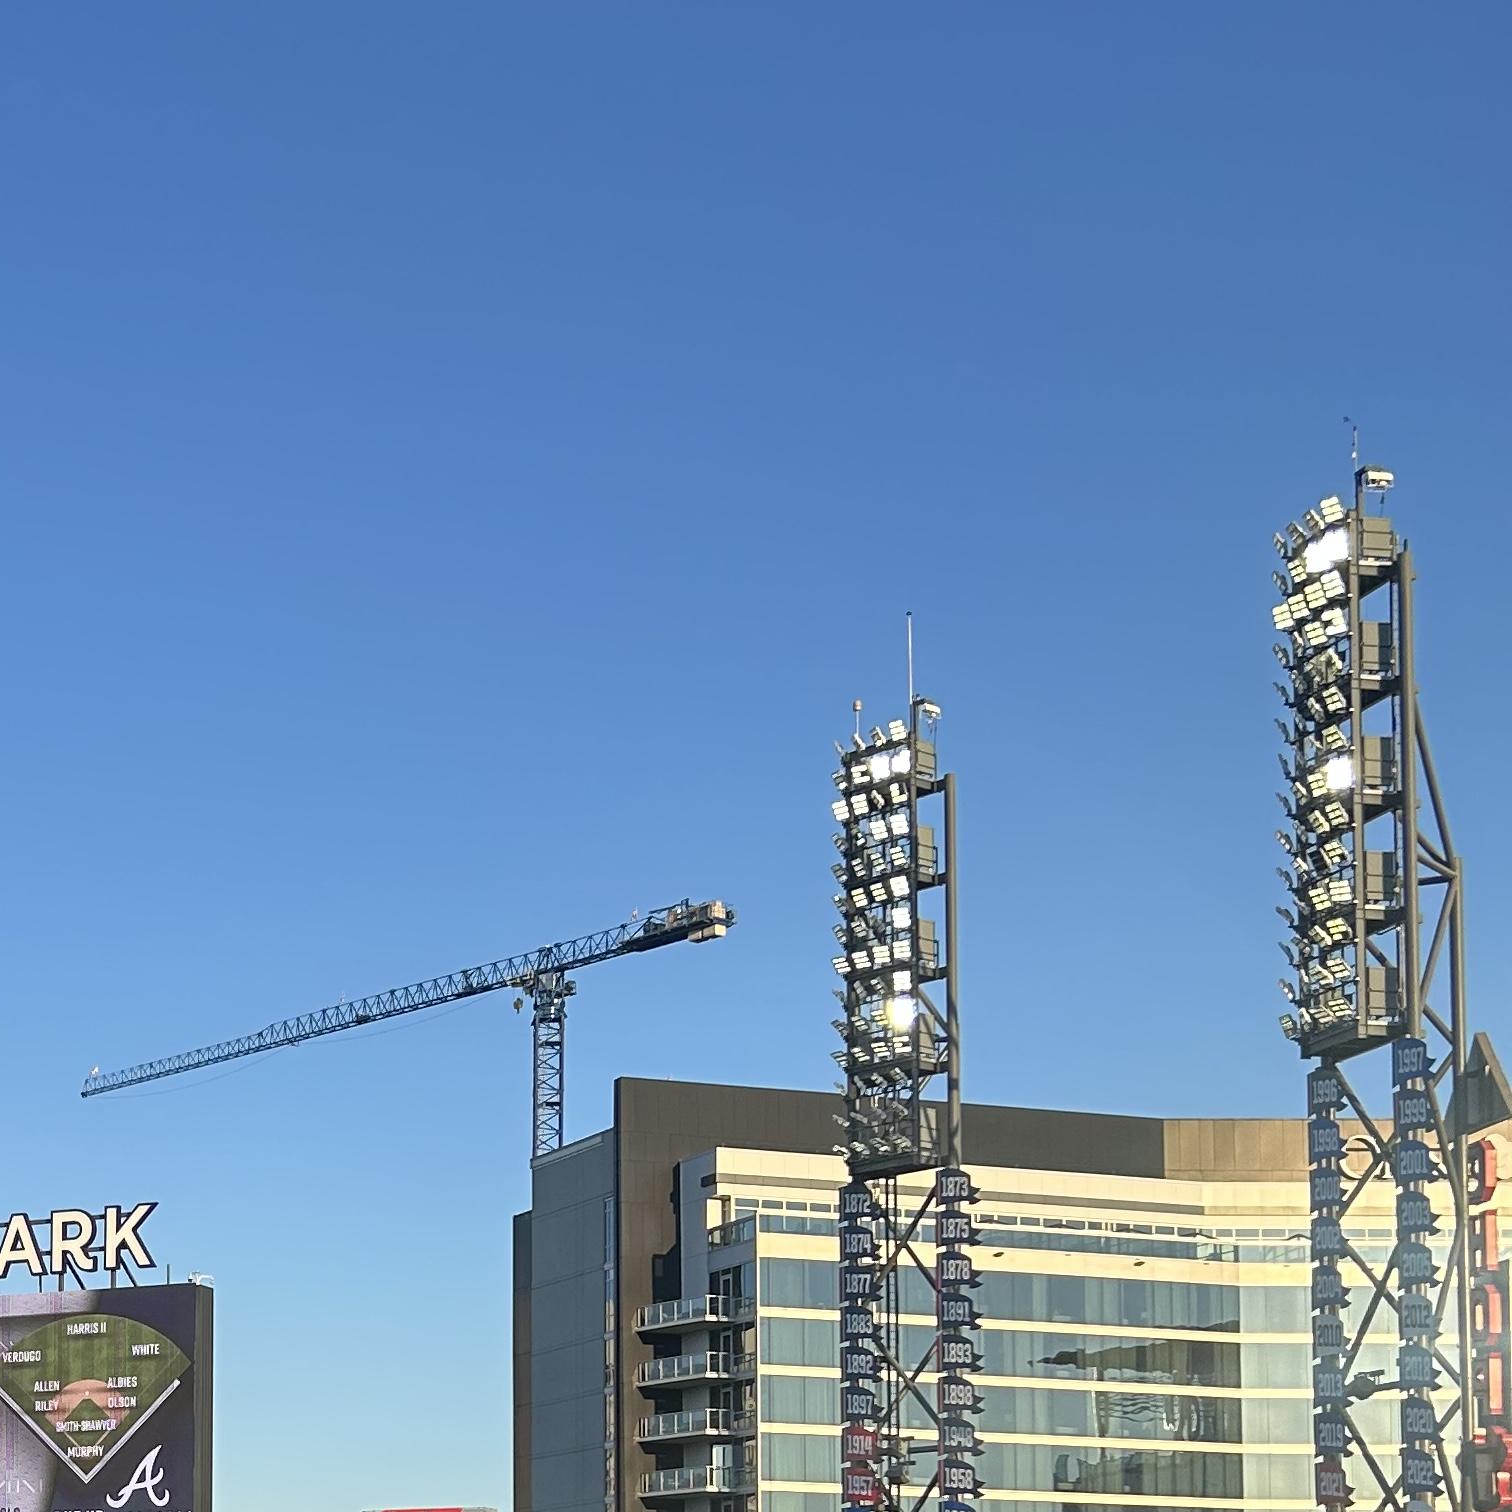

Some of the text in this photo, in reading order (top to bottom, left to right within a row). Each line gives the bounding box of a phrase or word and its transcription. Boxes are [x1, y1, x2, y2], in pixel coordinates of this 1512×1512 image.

[1398, 1048, 1424, 1073] 1997
[1400, 1149, 1428, 1174] 2001
[941, 1176, 968, 1197] 1873
[844, 1193, 871, 1213] 1872
[941, 1218, 969, 1238] 1875
[942, 1260, 970, 1280] 1878
[943, 1302, 970, 1322] 1891
[1404, 1304, 1431, 1329] 2012
[67, 1322, 98, 1335] HARRIS
[2, 1350, 41, 1363] VERDUGO
[131, 1343, 160, 1356] WHITE
[34, 1380, 60, 1392] ALLEN
[34, 1399, 59, 1412] RILEY
[107, 1396, 137, 1408] OLSON
[1406, 1407, 1433, 1433] 2020
[67, 1446, 104, 1458] MURPHY
[847, 1434, 873, 1455] 1914
[944, 1468, 974, 1489] 1958
